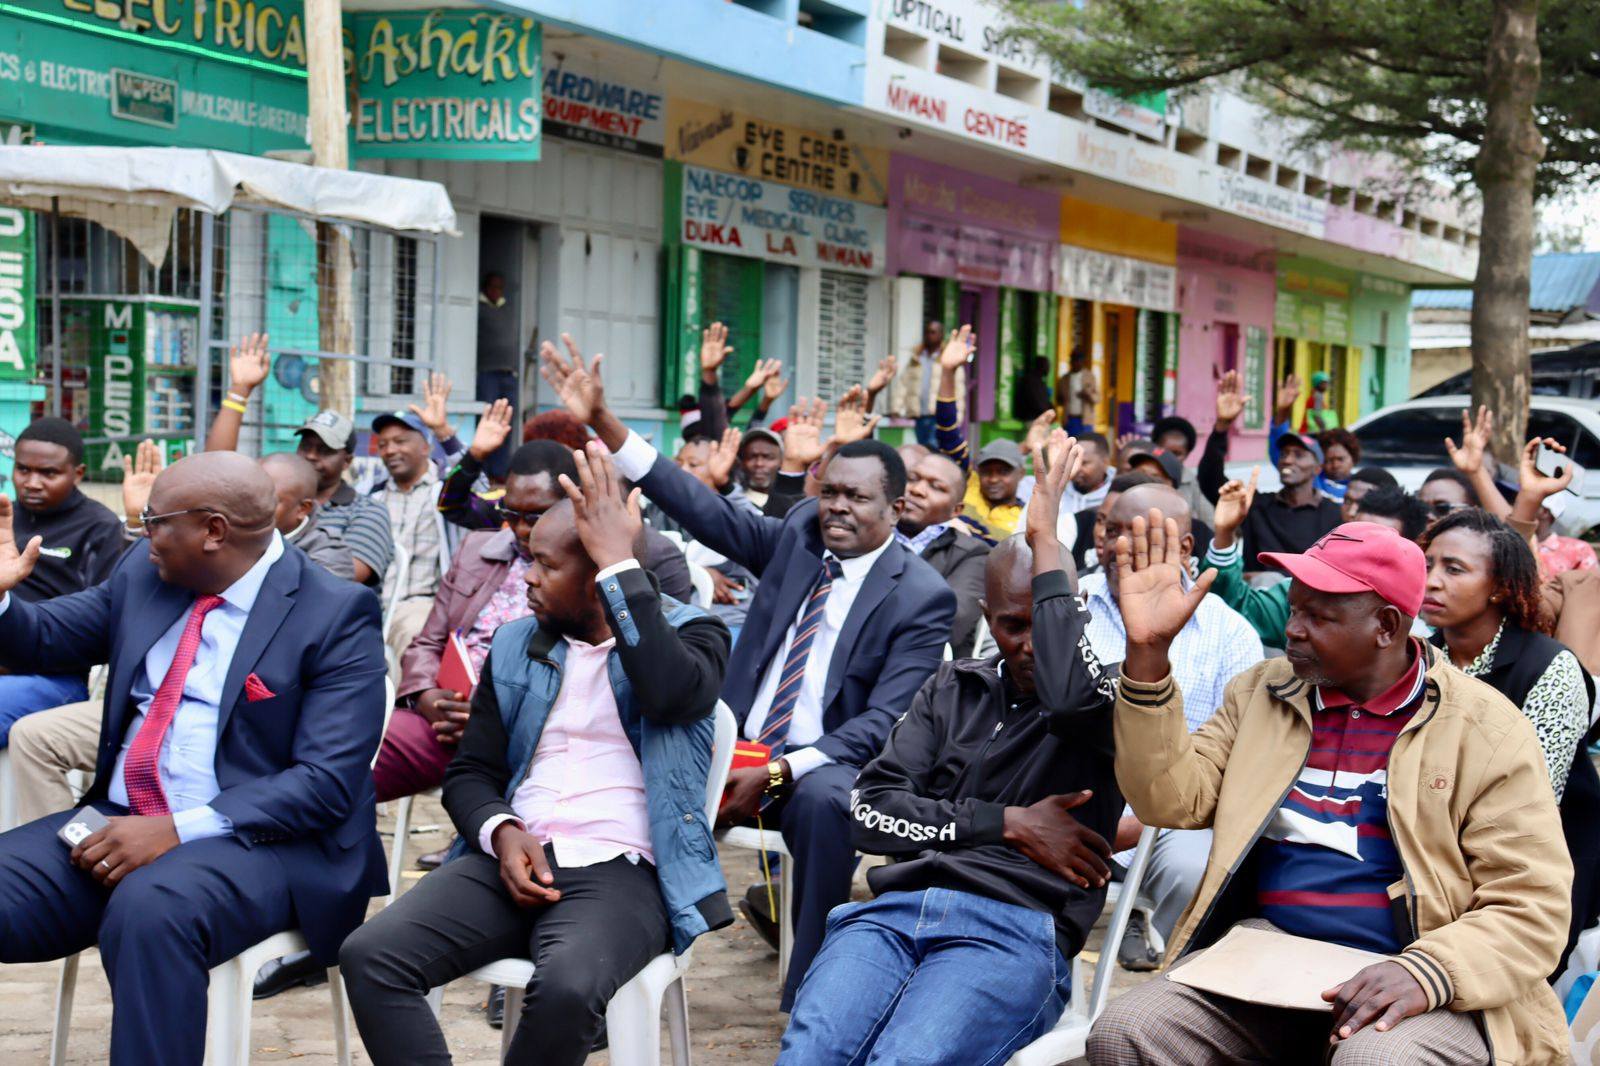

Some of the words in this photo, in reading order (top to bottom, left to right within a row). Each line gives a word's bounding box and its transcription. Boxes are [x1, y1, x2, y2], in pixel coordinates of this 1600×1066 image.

[893, 0, 965, 41] OPTICAL
[360, 8, 540, 87] Ashaki
[542, 67, 662, 120] ARDWARE
[355, 98, 540, 143] ELECTRICALS
[542, 95, 643, 139] QUIPMENT
[887, 82, 946, 123] MIWANI
[964, 108, 1028, 148] CENTRE
[745, 121, 784, 153] EYE
[762, 152, 835, 190] CENTRE
[685, 195, 718, 220] EYE
[685, 218, 743, 248] DUKA
[766, 232, 797, 257] LA
